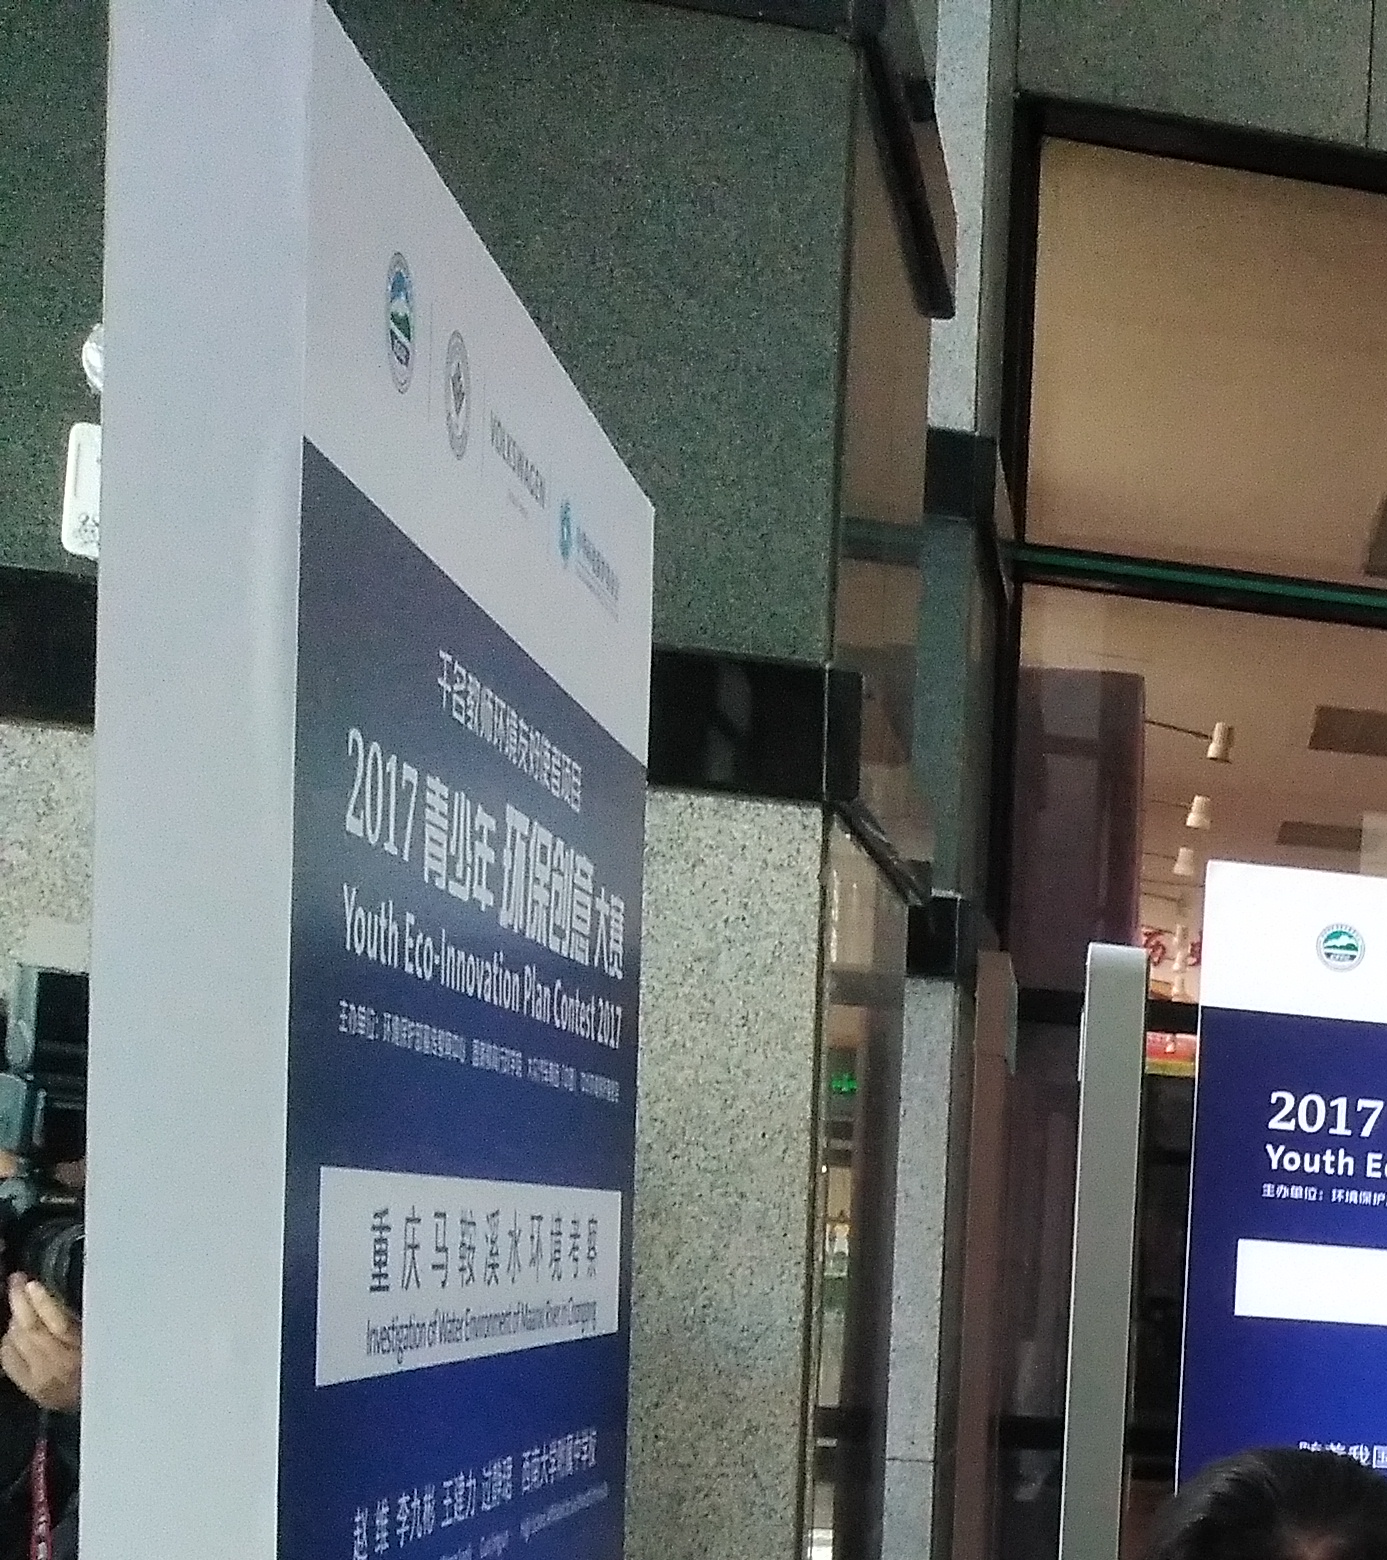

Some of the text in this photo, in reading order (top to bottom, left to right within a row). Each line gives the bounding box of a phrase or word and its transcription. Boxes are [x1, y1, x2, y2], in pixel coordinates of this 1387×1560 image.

[346, 727, 624, 982] 2017 青少年 环保创意 大赛
[342, 884, 621, 1051] Youth Eco-Innovation Plan Contest 2017
[1268, 1089, 1383, 1139] 2017
[1265, 1143, 1354, 1178] Youth
[368, 1206, 598, 1295] 重庆马鞍溪水环境考察
[366, 1314, 426, 1368] Investigation
[427, 1308, 439, 1347] of
[438, 1309, 461, 1349] Water
